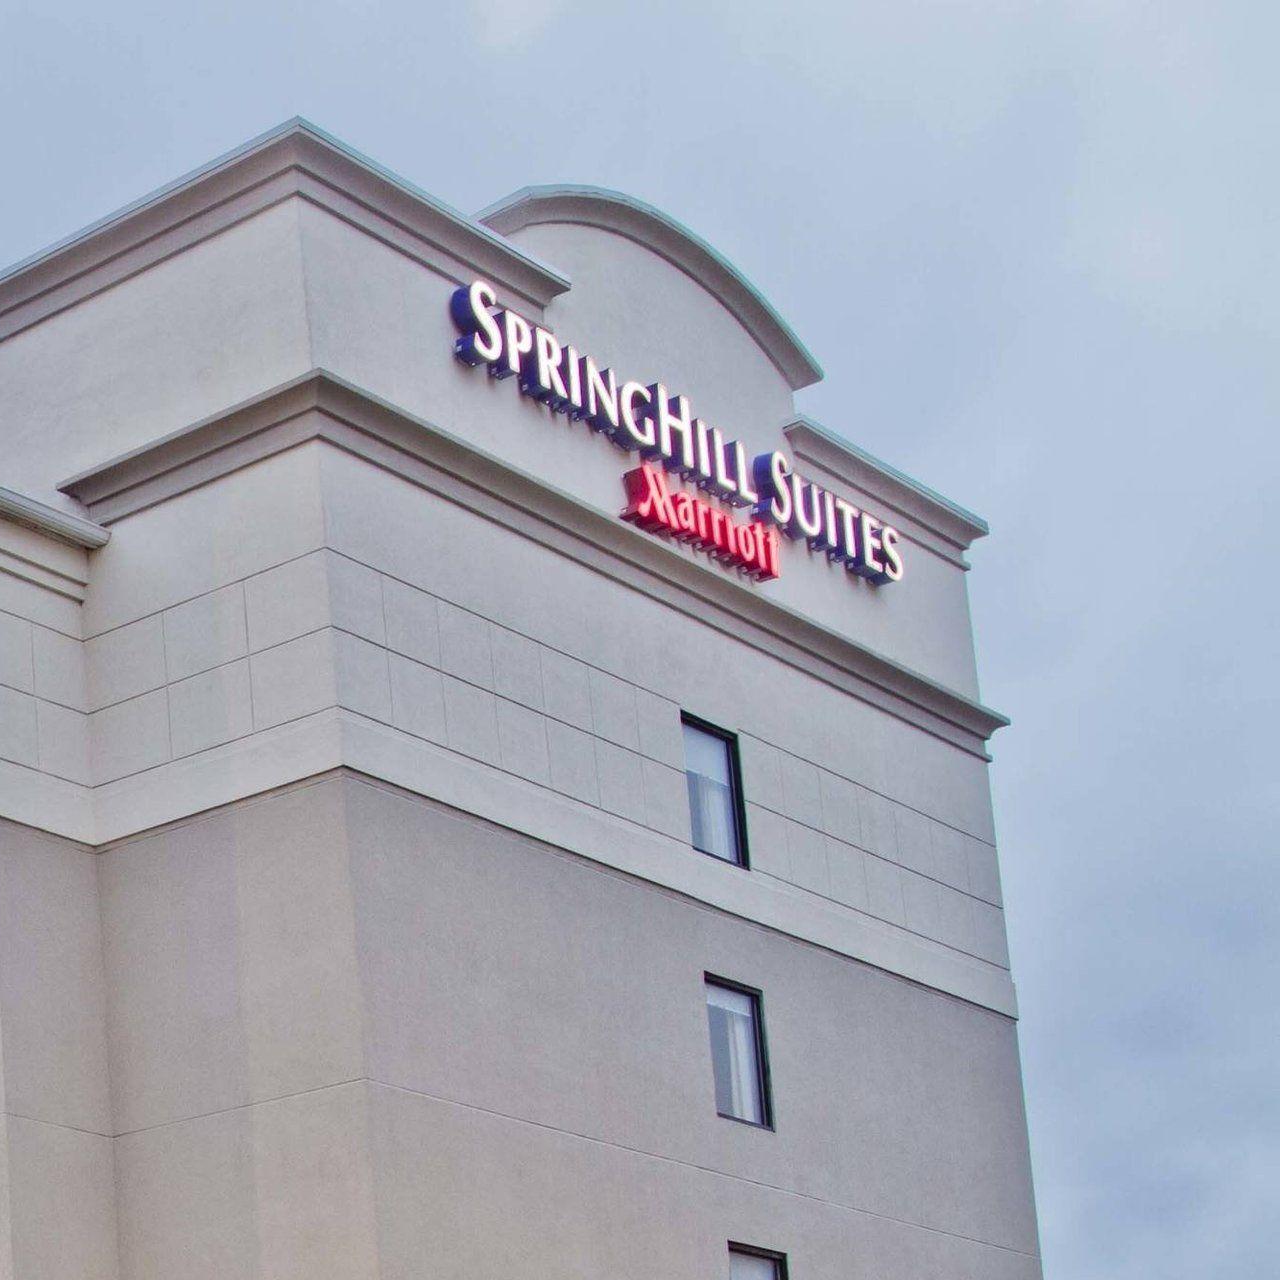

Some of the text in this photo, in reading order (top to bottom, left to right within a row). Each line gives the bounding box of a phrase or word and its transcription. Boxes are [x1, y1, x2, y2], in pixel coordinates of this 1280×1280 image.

[462, 279, 904, 582] SPRINGHILL SUITES
[633, 463, 781, 580] Marriott
